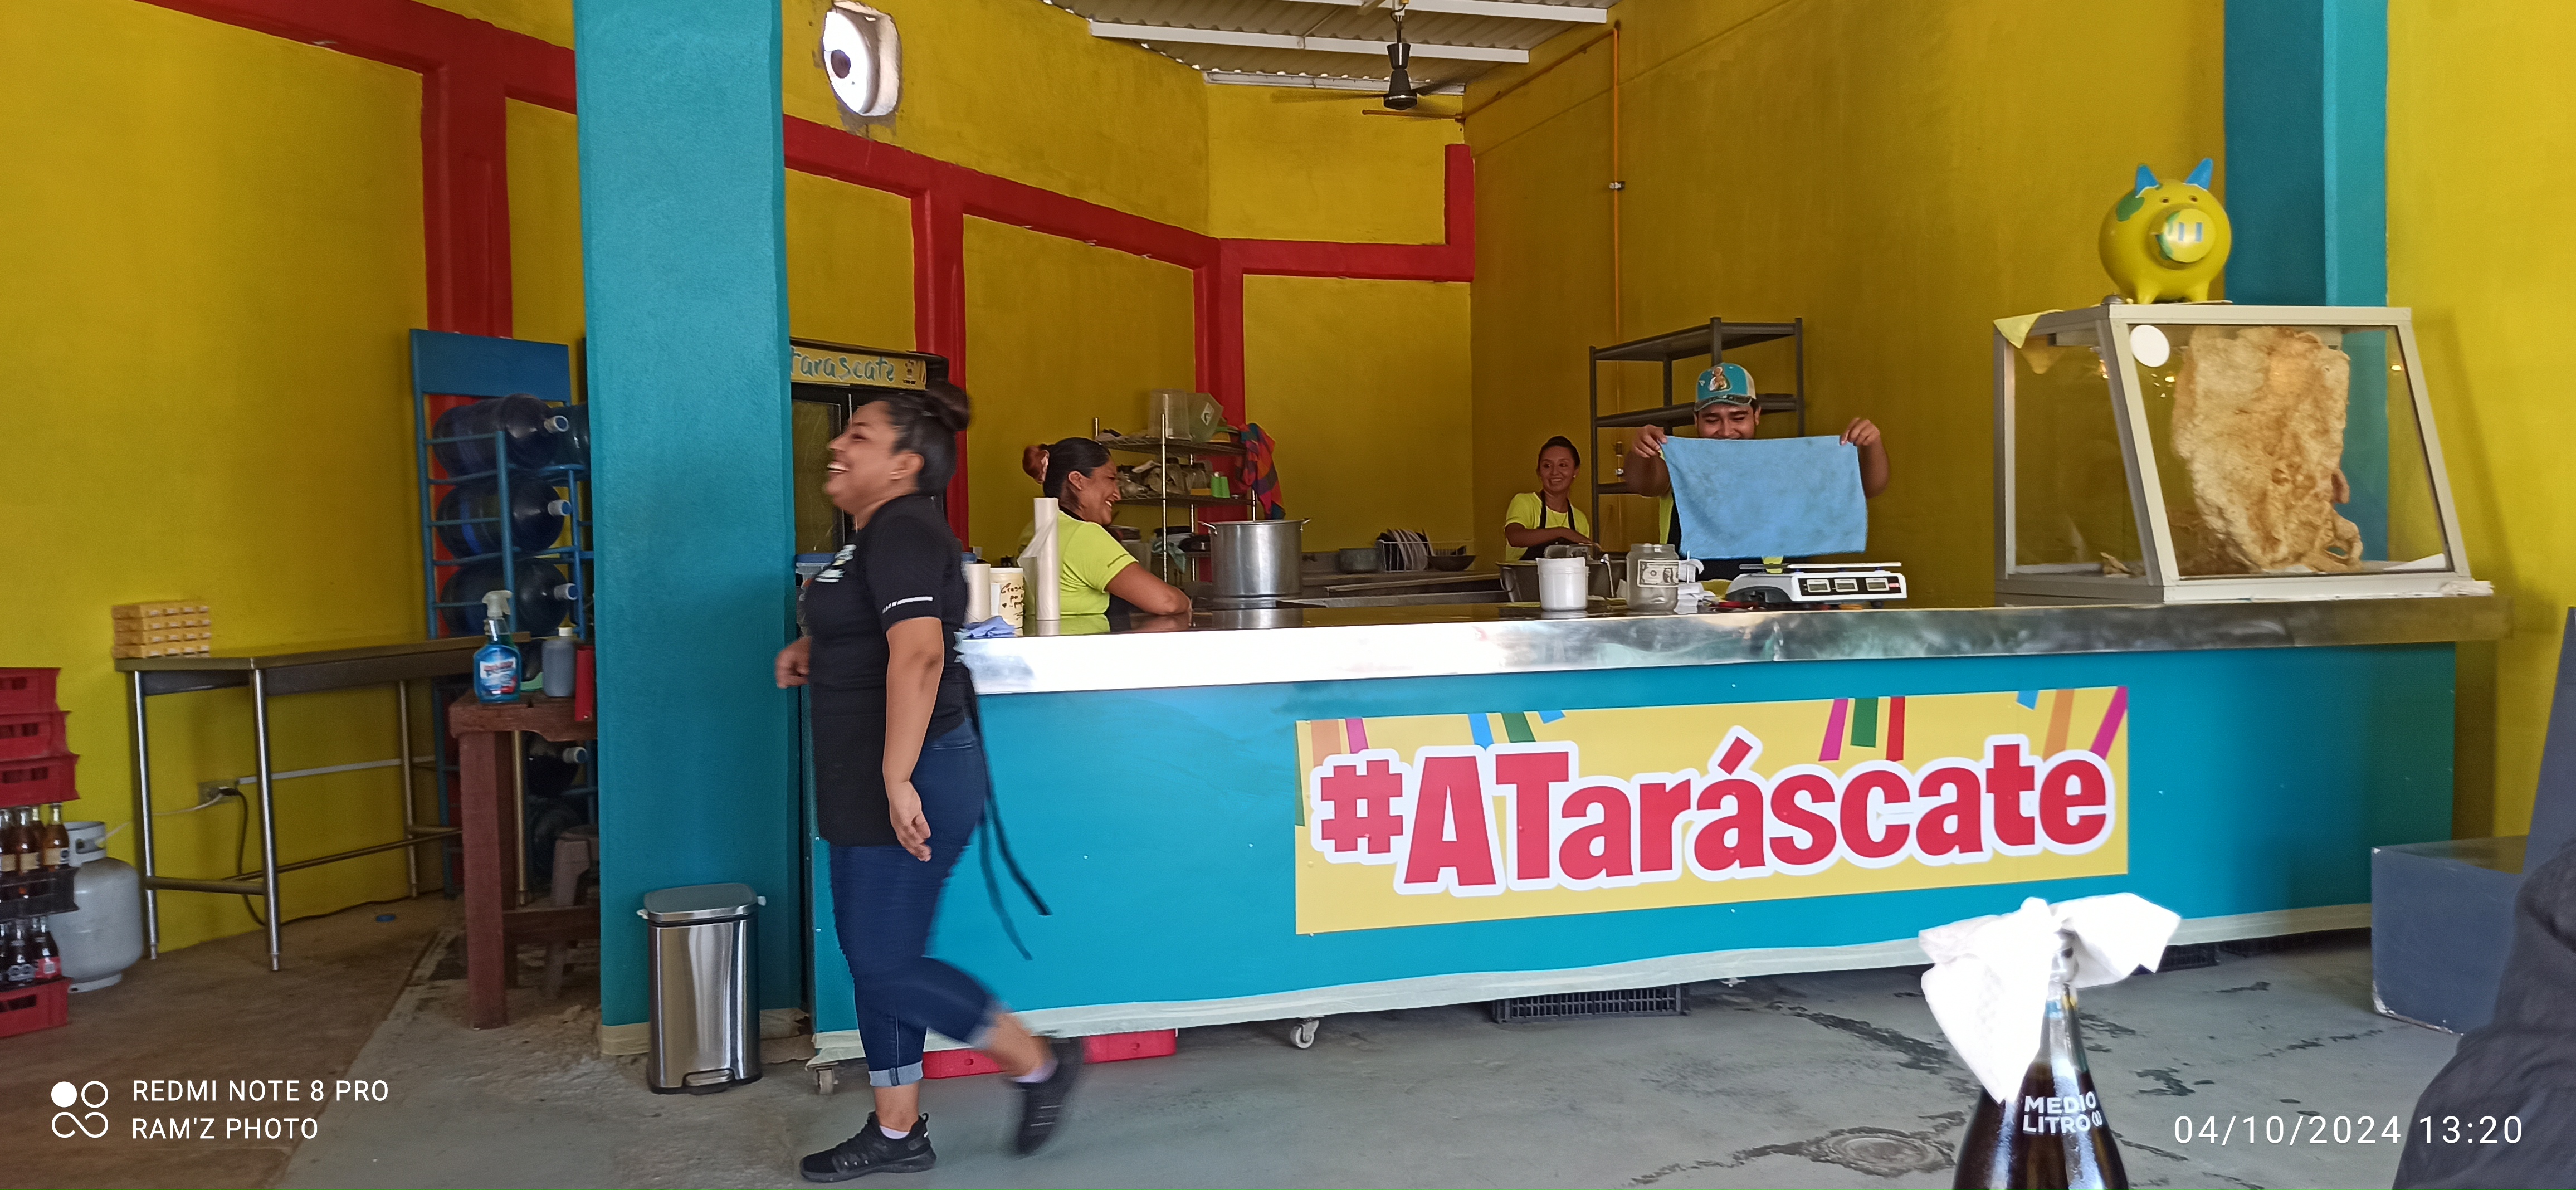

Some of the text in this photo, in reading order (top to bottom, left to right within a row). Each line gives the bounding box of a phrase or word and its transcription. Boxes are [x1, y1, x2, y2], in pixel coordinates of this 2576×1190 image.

[1320, 736, 2106, 887] #ATaráscate
[2024, 1091, 2097, 1114] MEDIO
[2022, 1114, 2091, 1134] LITRO
